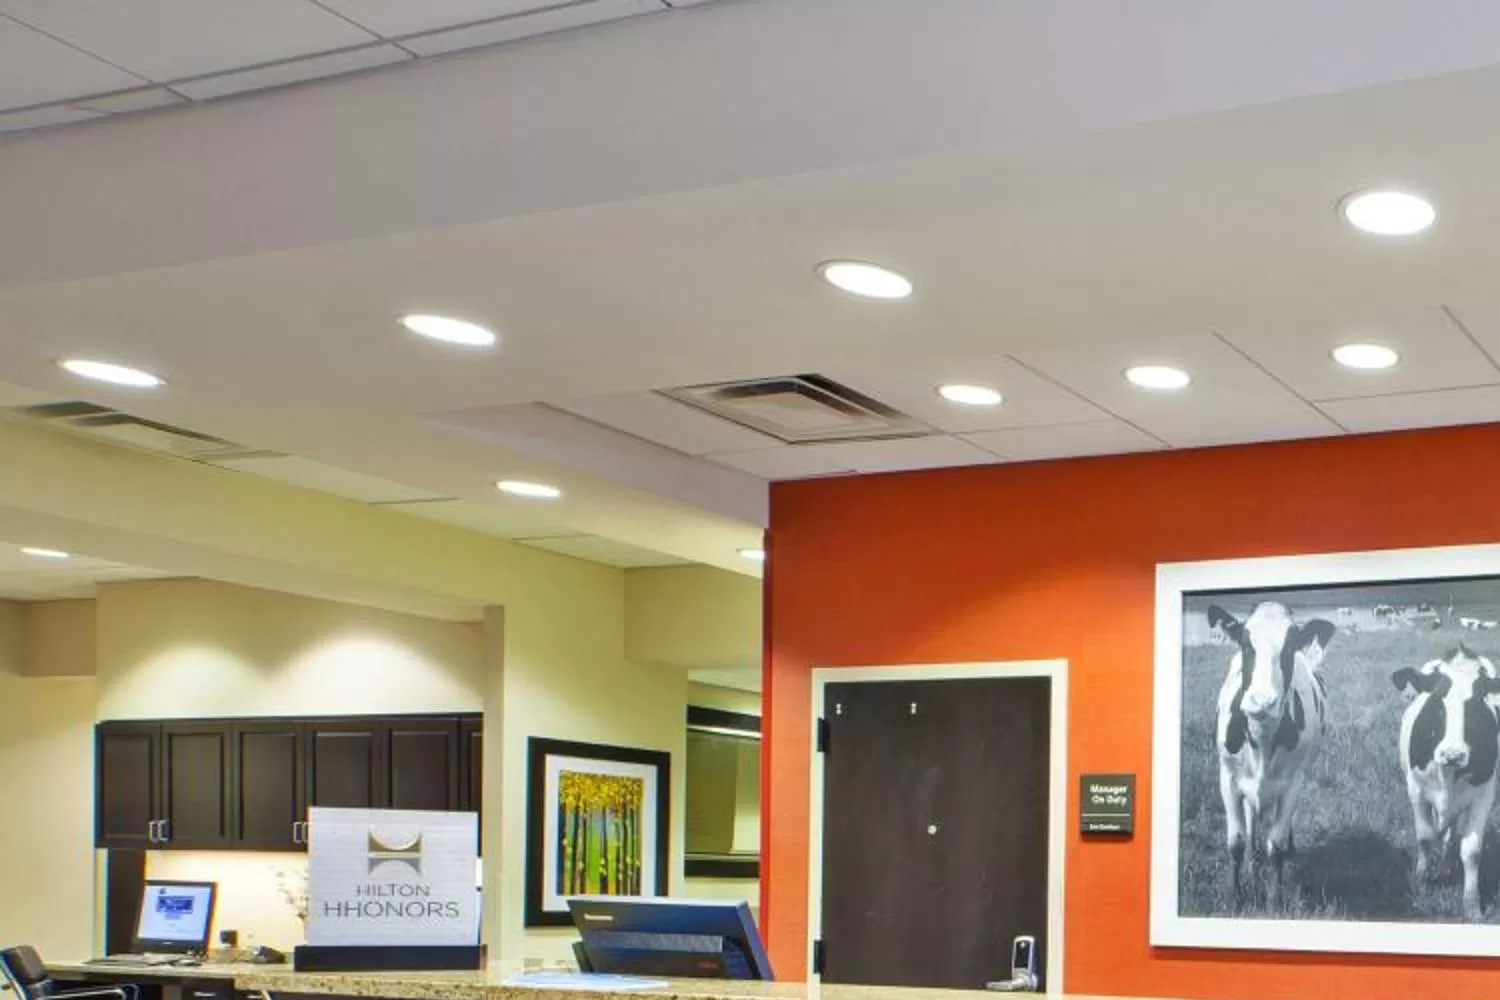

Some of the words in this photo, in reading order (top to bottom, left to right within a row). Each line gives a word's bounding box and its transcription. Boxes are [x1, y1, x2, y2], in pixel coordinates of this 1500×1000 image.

[1089, 784, 1128, 795] Manager
[1091, 795, 1105, 805] On
[1106, 795, 1127, 808] Duty
[355, 883, 431, 897] HILTON
[323, 900, 461, 918] HHONORS
